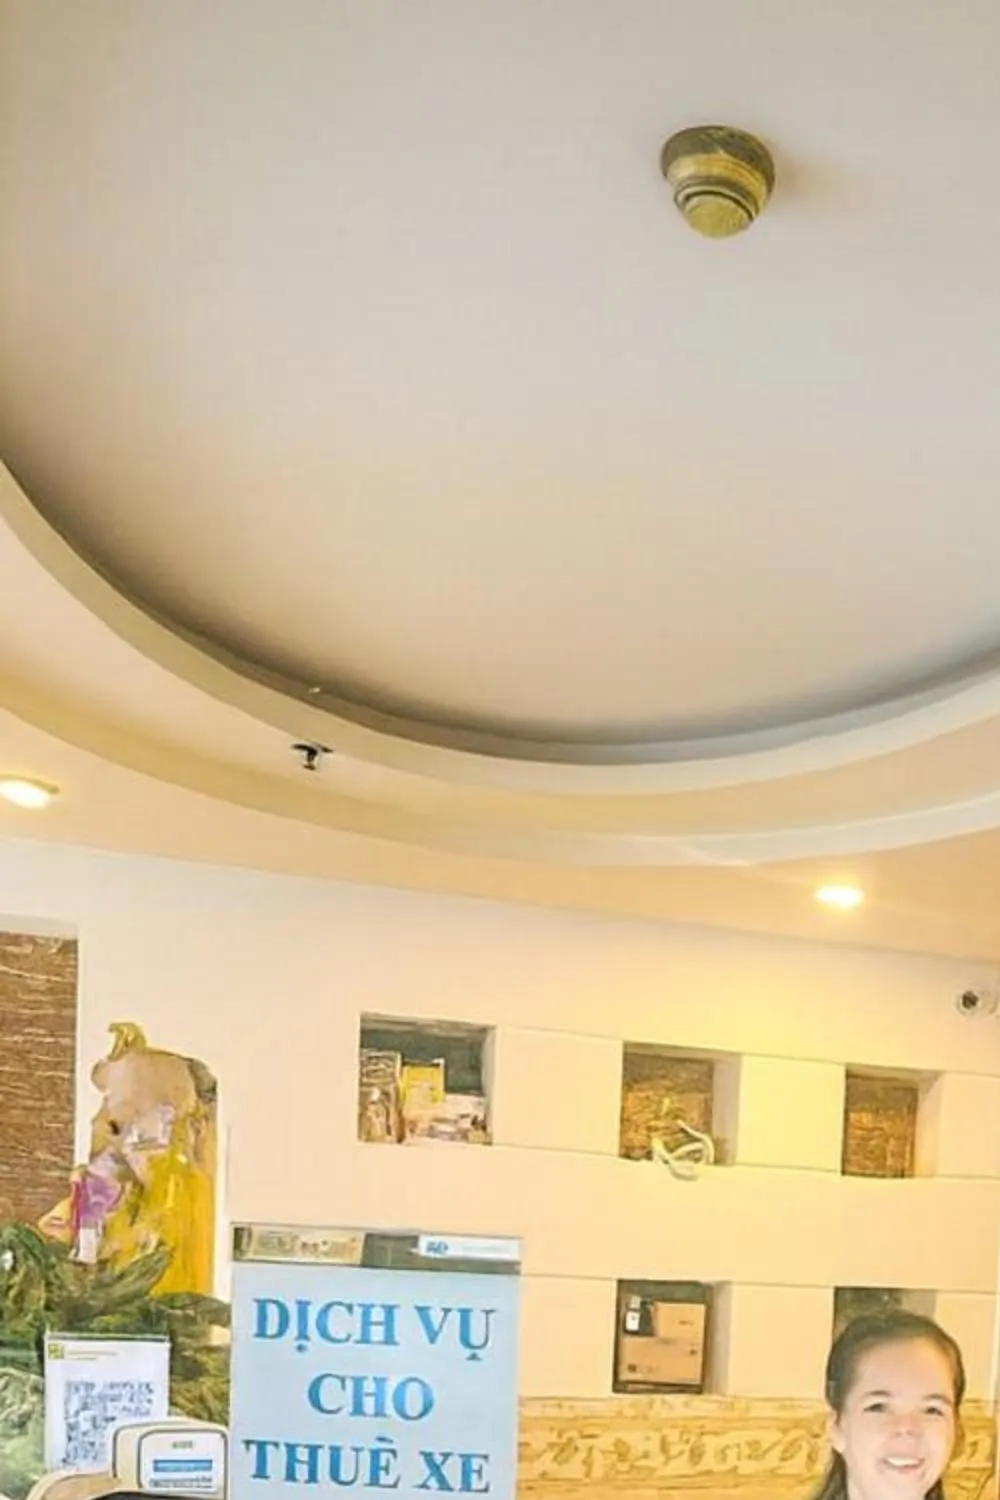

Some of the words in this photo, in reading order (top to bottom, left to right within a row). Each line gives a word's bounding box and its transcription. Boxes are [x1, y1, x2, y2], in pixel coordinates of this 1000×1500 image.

[253, 1297, 399, 1352] DỊCH
[414, 1304, 497, 1361] VỤ
[307, 1372, 434, 1421] CHO
[414, 1450, 491, 1494] XE
